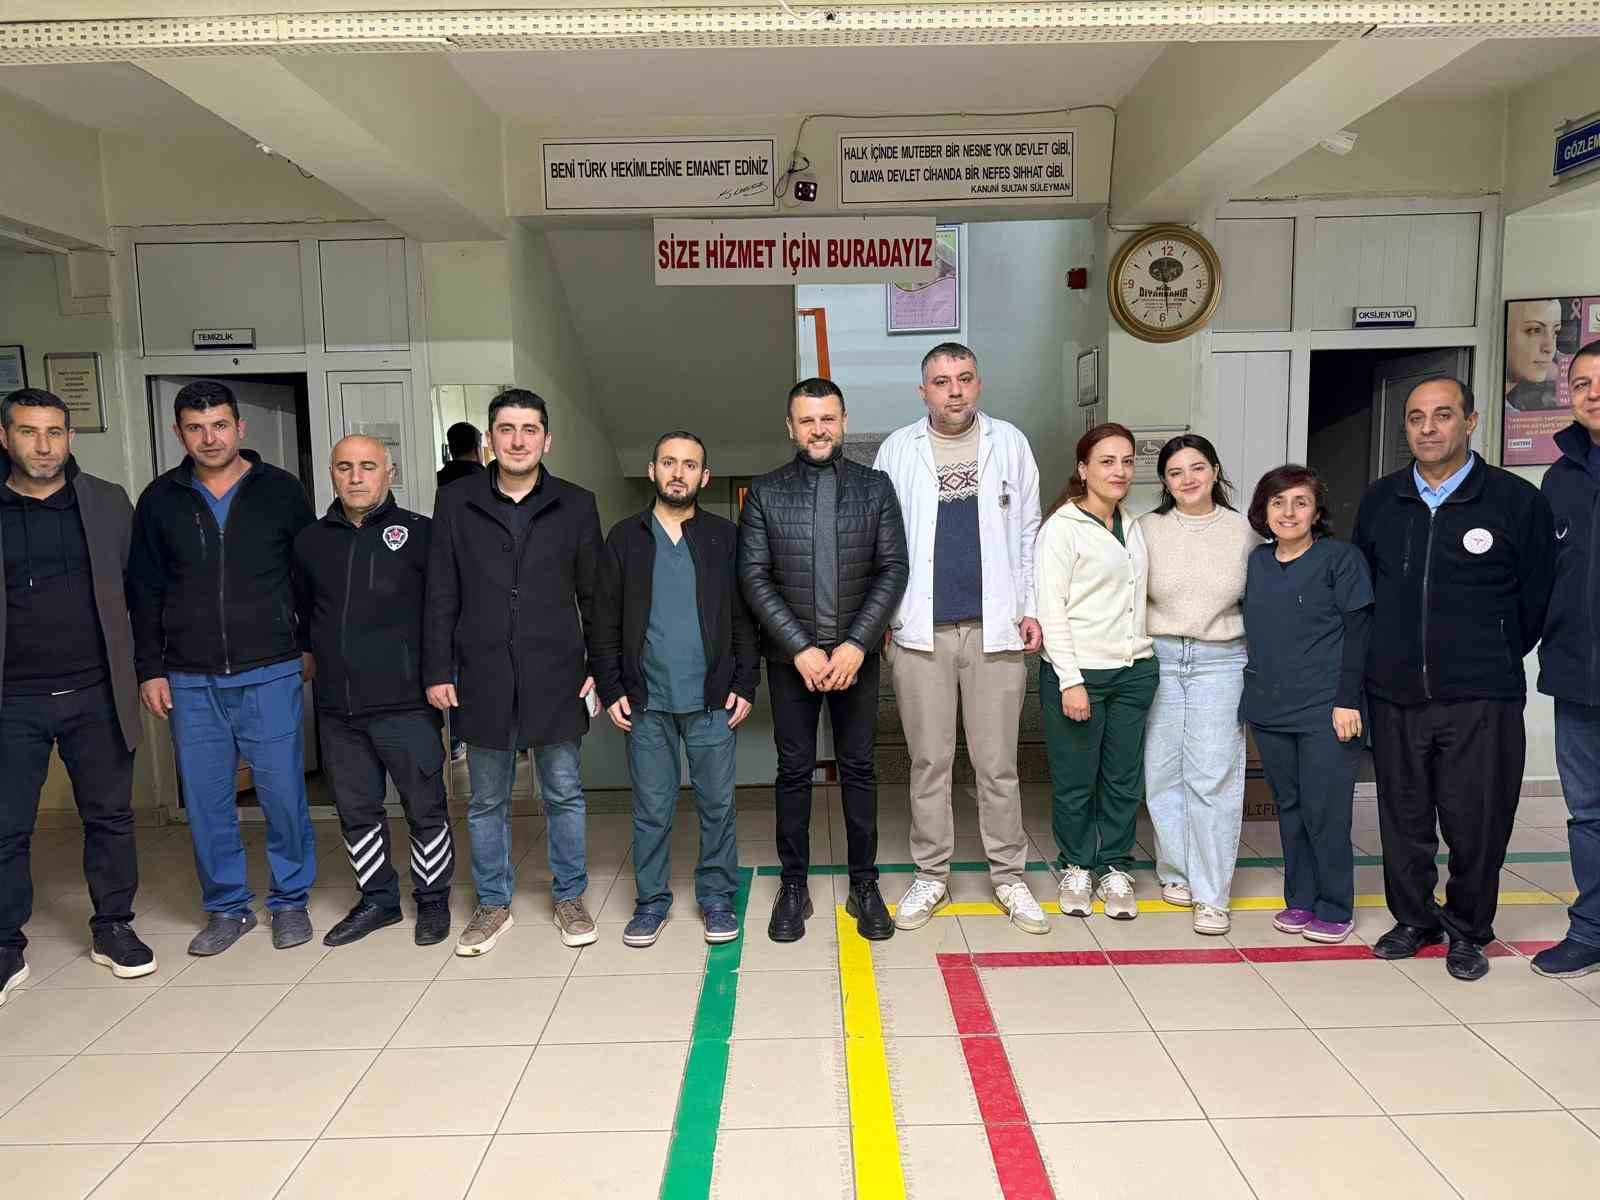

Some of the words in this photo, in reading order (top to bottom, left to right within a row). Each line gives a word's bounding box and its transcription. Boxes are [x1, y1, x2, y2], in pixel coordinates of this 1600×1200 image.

[844, 146, 868, 160] HALK
[871, 143, 898, 163] İÇİNDE
[901, 145, 943, 159] MUTEBER
[946, 142, 960, 158] BİR
[963, 144, 992, 157] NESNE
[994, 143, 1012, 156] YOK
[1015, 142, 1048, 156] DEVLET
[550, 159, 576, 179] BENİ
[578, 159, 608, 178] TÜRK
[611, 158, 682, 177] HEKİMLERİNE
[686, 159, 731, 176] EMANET
[735, 156, 768, 176] EDİNİZ
[849, 169, 884, 183] OLMAYA
[887, 168, 920, 182] DEVLET
[923, 166, 962, 181] CİHANDA
[965, 164, 980, 180] BİR
[982, 166, 1010, 180] NEFES
[1013, 165, 1044, 179] SIHHAT
[1000, 182, 1028, 193] SULTAN
[1030, 182, 1071, 192] SÜLEYMAN
[658, 233, 700, 269] SİZE
[705, 233, 776, 269] HİZMET
[782, 232, 821, 276] İÇİN
[826, 238, 933, 268] BURADAYIZ
[1161, 246, 1174, 256] 12
[1127, 279, 1135, 289] 9
[1195, 279, 1202, 289] 3
[1159, 312, 1167, 322] 6
[1358, 310, 1391, 319] OKSİJEN
